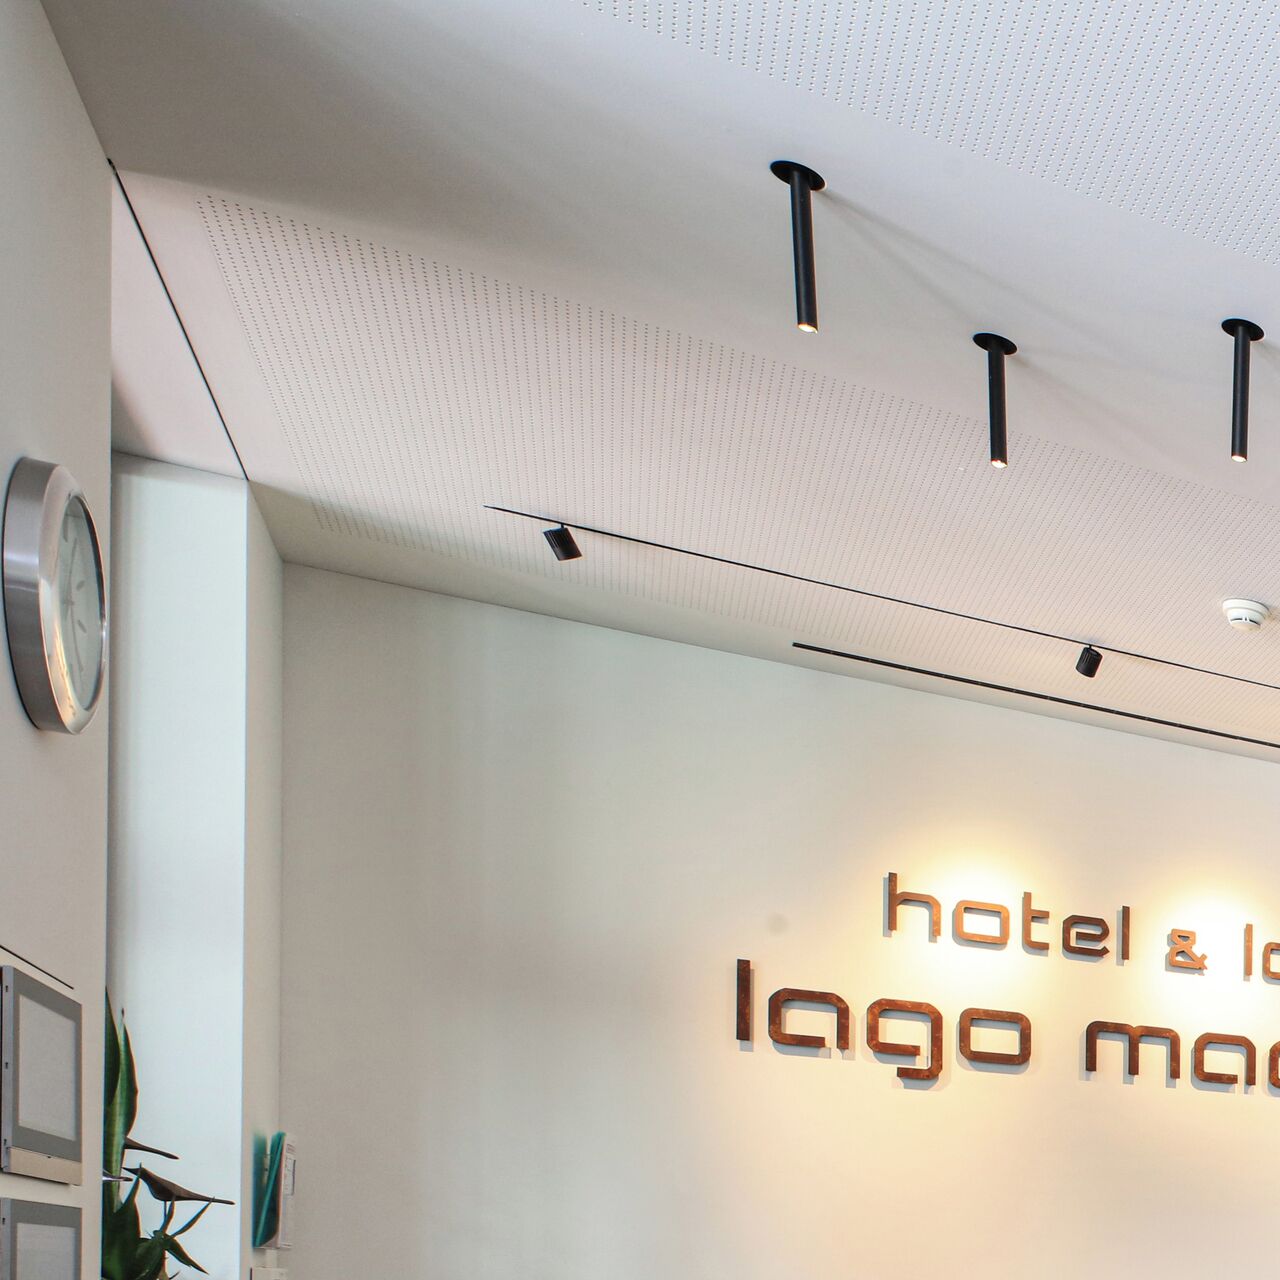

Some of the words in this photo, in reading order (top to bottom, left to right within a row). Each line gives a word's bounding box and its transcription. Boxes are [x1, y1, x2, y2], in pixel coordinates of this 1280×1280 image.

[886, 871, 1132, 962] hotel
[1167, 926, 1208, 972] &
[736, 957, 1033, 1082] lago
